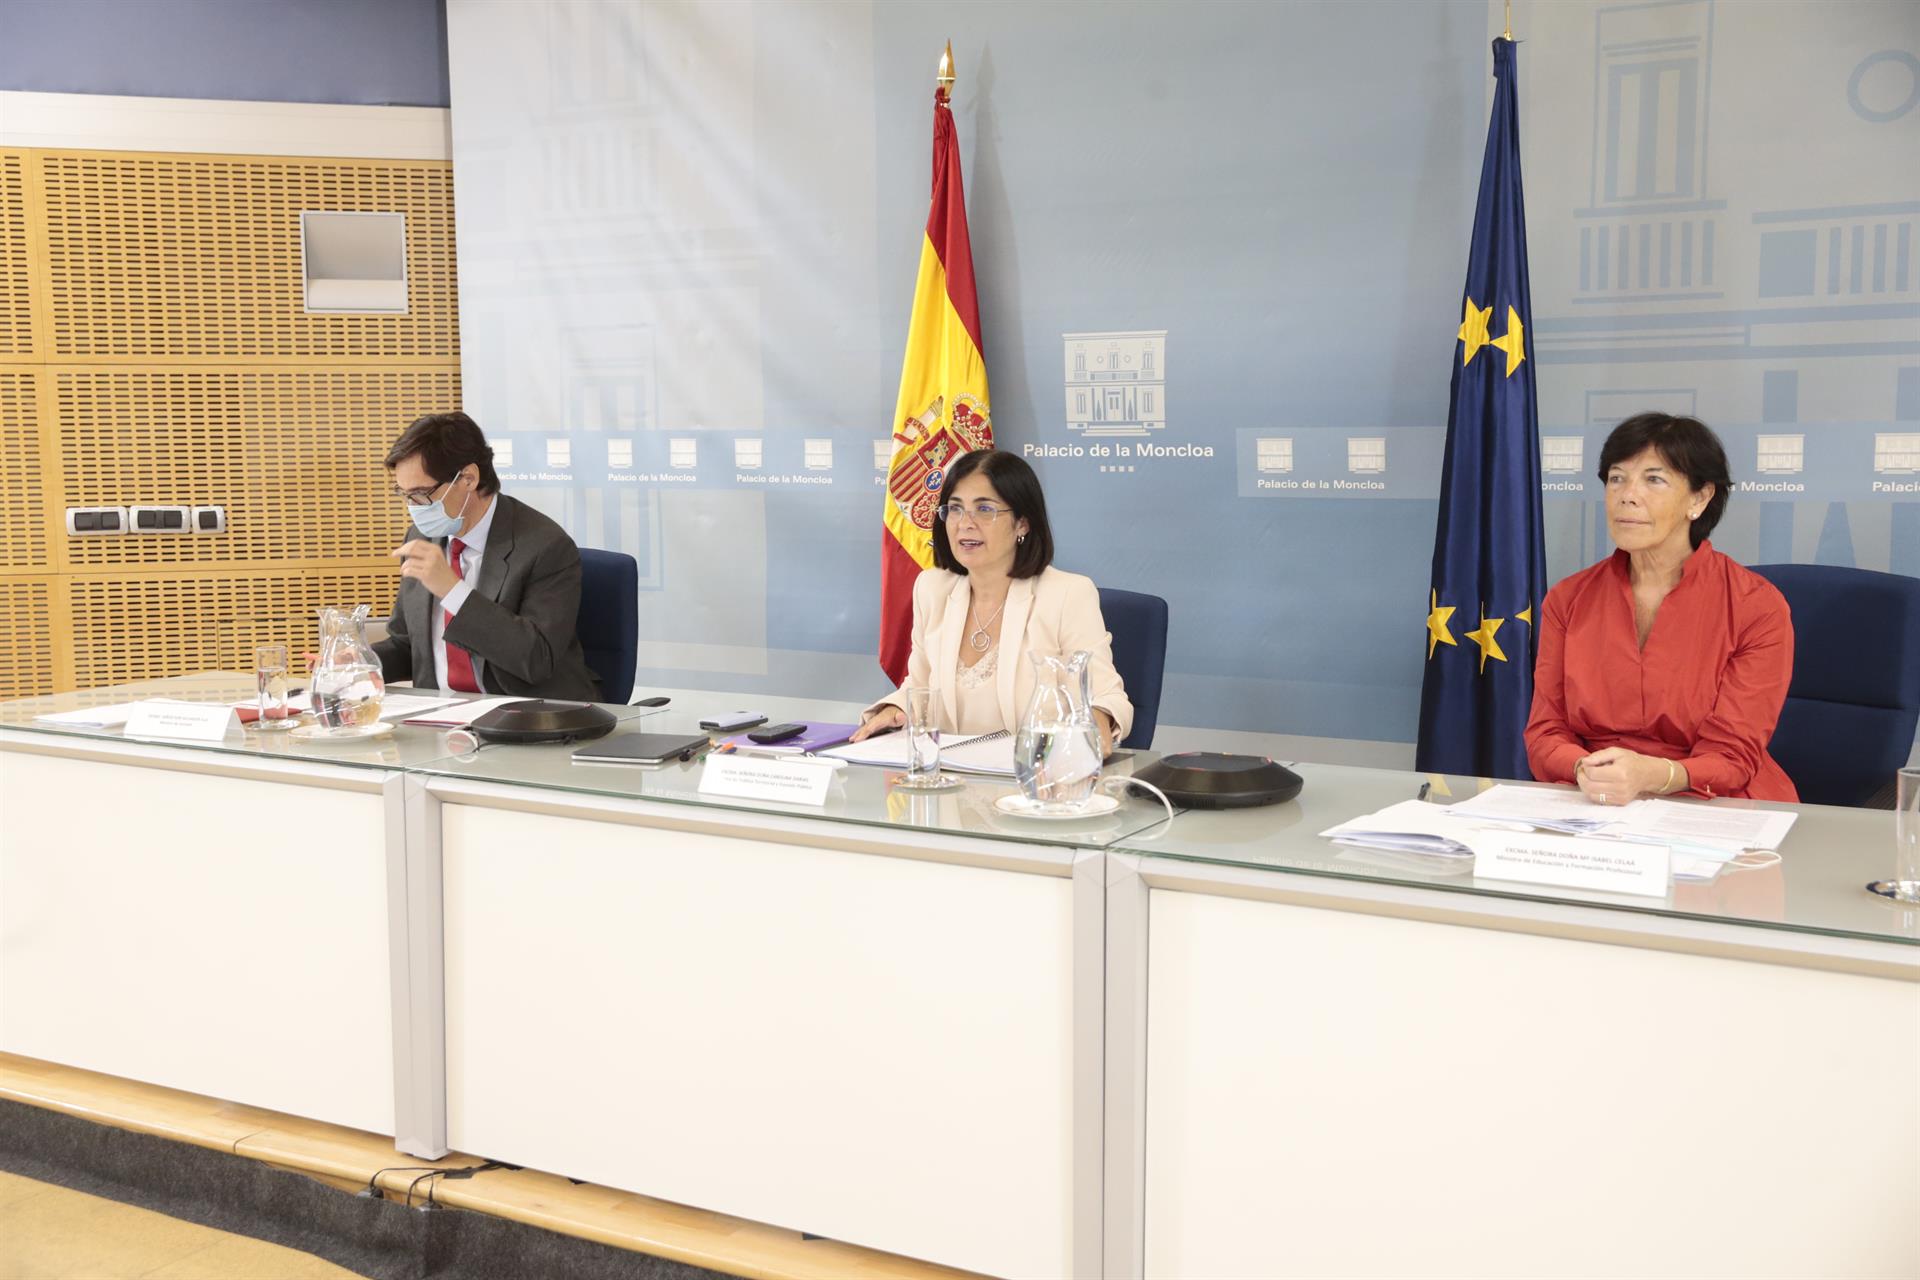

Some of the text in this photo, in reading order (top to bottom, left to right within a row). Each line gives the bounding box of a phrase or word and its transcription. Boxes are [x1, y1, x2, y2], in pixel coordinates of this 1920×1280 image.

[1023, 443, 1214, 458] Palacio de la Moncloa
[519, 472, 529, 480] de
[539, 472, 573, 481] Moncloa
[608, 473, 697, 482] Palacio de la Moncloa
[736, 474, 833, 485] Palacio de la Moncloa
[1257, 479, 1385, 490] Palacio de la Moncloa
[1541, 481, 1584, 491] oncloa
[1741, 481, 1805, 492] Moncloa
[1872, 481, 1920, 492] Palaci
